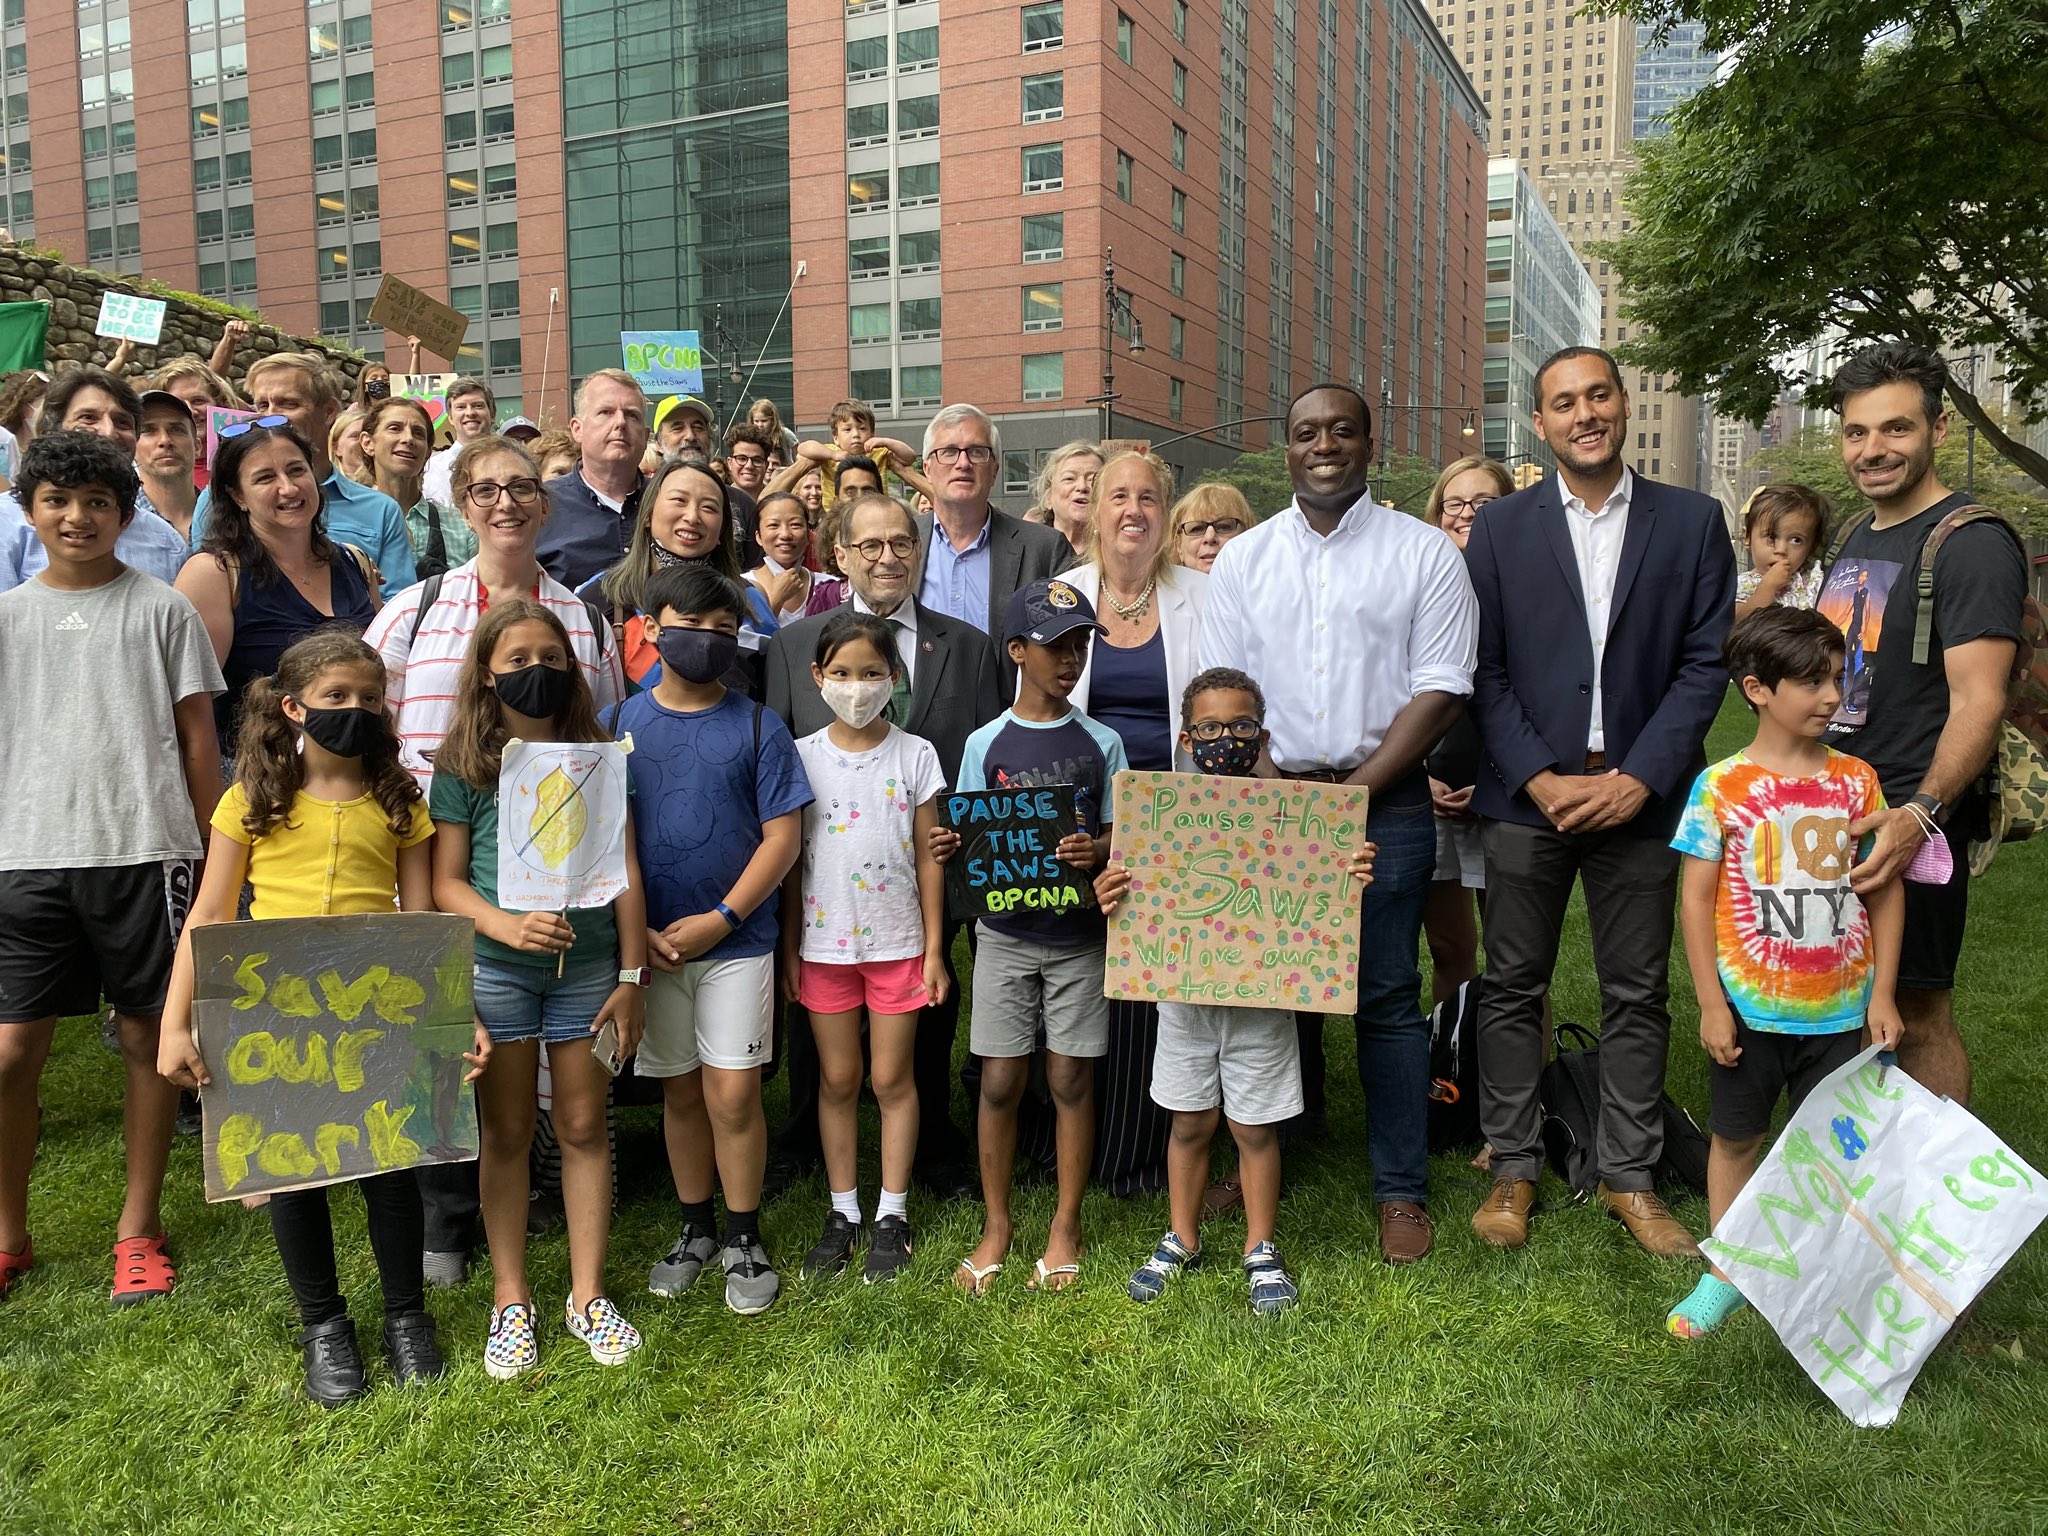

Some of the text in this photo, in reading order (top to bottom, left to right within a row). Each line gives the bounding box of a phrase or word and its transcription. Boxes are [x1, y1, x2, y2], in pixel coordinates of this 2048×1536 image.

[105, 305, 156, 325] TO BE
[106, 293, 132, 307] WE
[404, 375, 441, 394] WE
[948, 791, 1059, 826] PAUSE
[1151, 787, 1355, 850] Pause the
[986, 828, 1044, 854] THE
[967, 854, 1060, 887] SAWS
[986, 885, 1080, 912] BPCNA
[1173, 849, 1351, 928] Saws!
[1753, 886, 1856, 940] NY
[1262, 948, 1323, 969] our
[231, 951, 427, 1024] Save
[1176, 971, 1284, 1003] trees!
[229, 1028, 386, 1093] our
[1811, 1284, 1928, 1408] the
